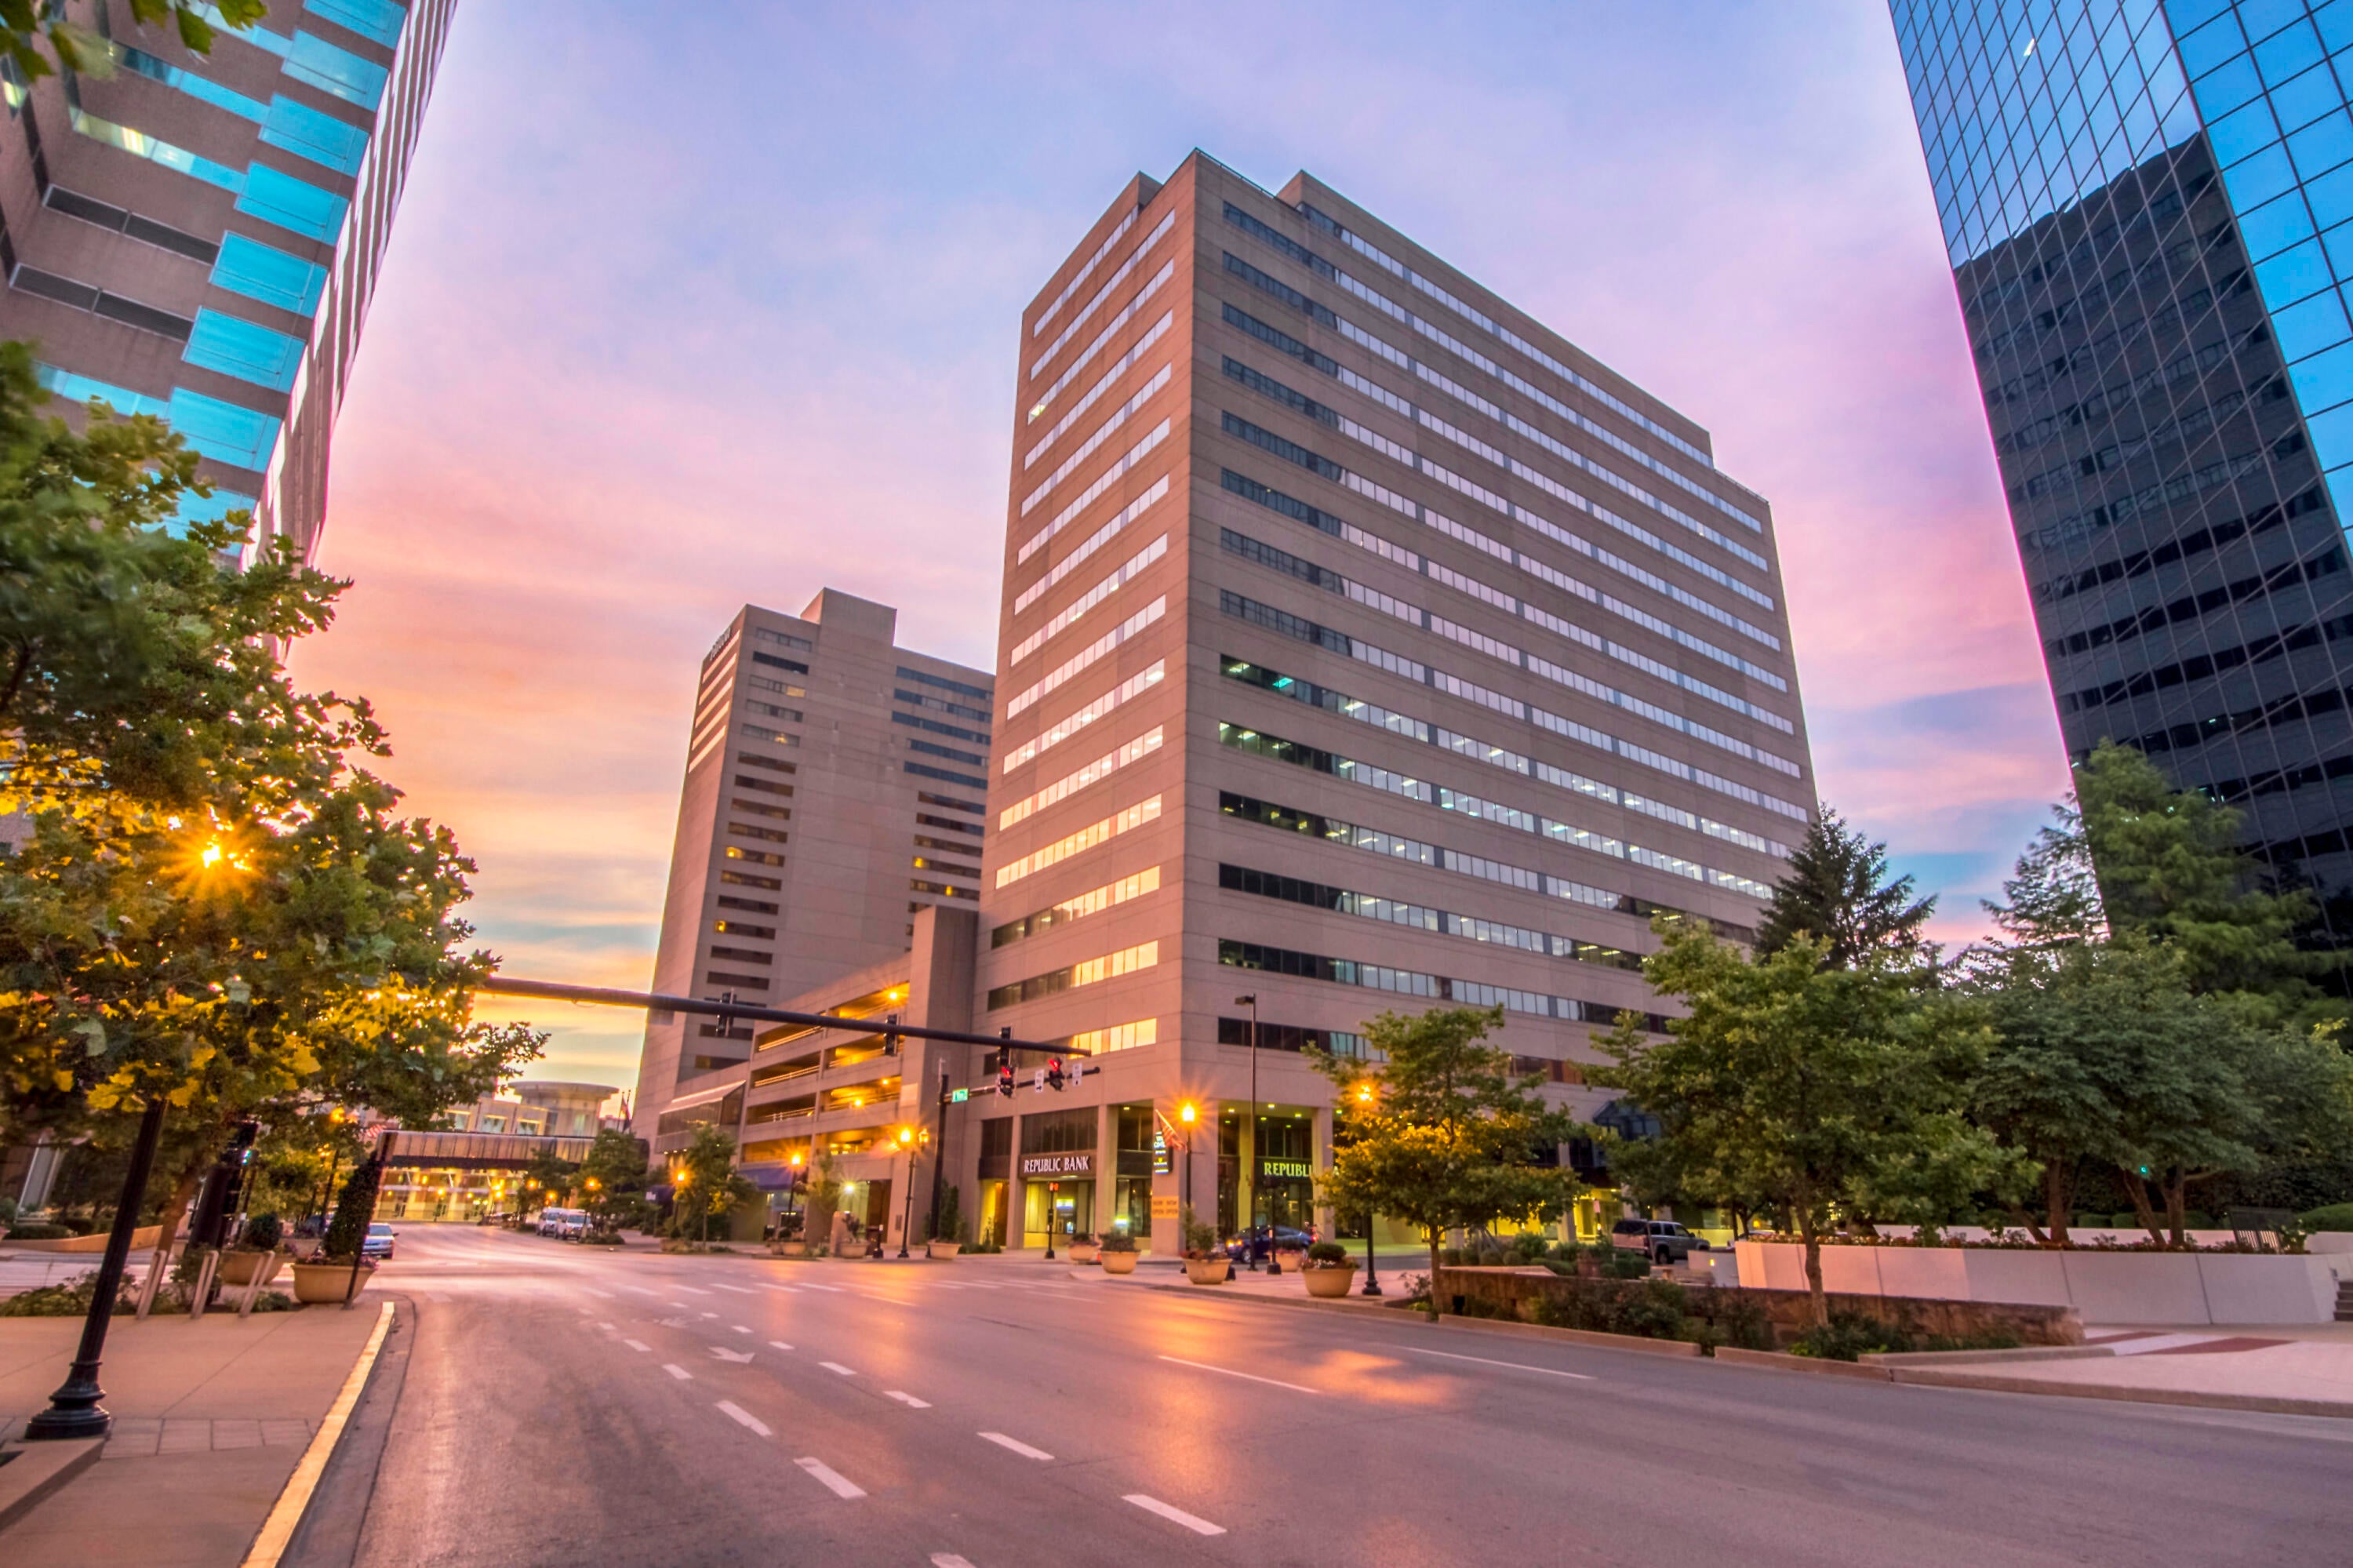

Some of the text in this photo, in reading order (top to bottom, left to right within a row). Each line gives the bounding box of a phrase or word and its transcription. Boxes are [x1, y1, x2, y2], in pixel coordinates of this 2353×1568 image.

[1024, 1156, 1089, 1173] REPUBLIC BANK
[1264, 1162, 1312, 1177] REPUBLI
